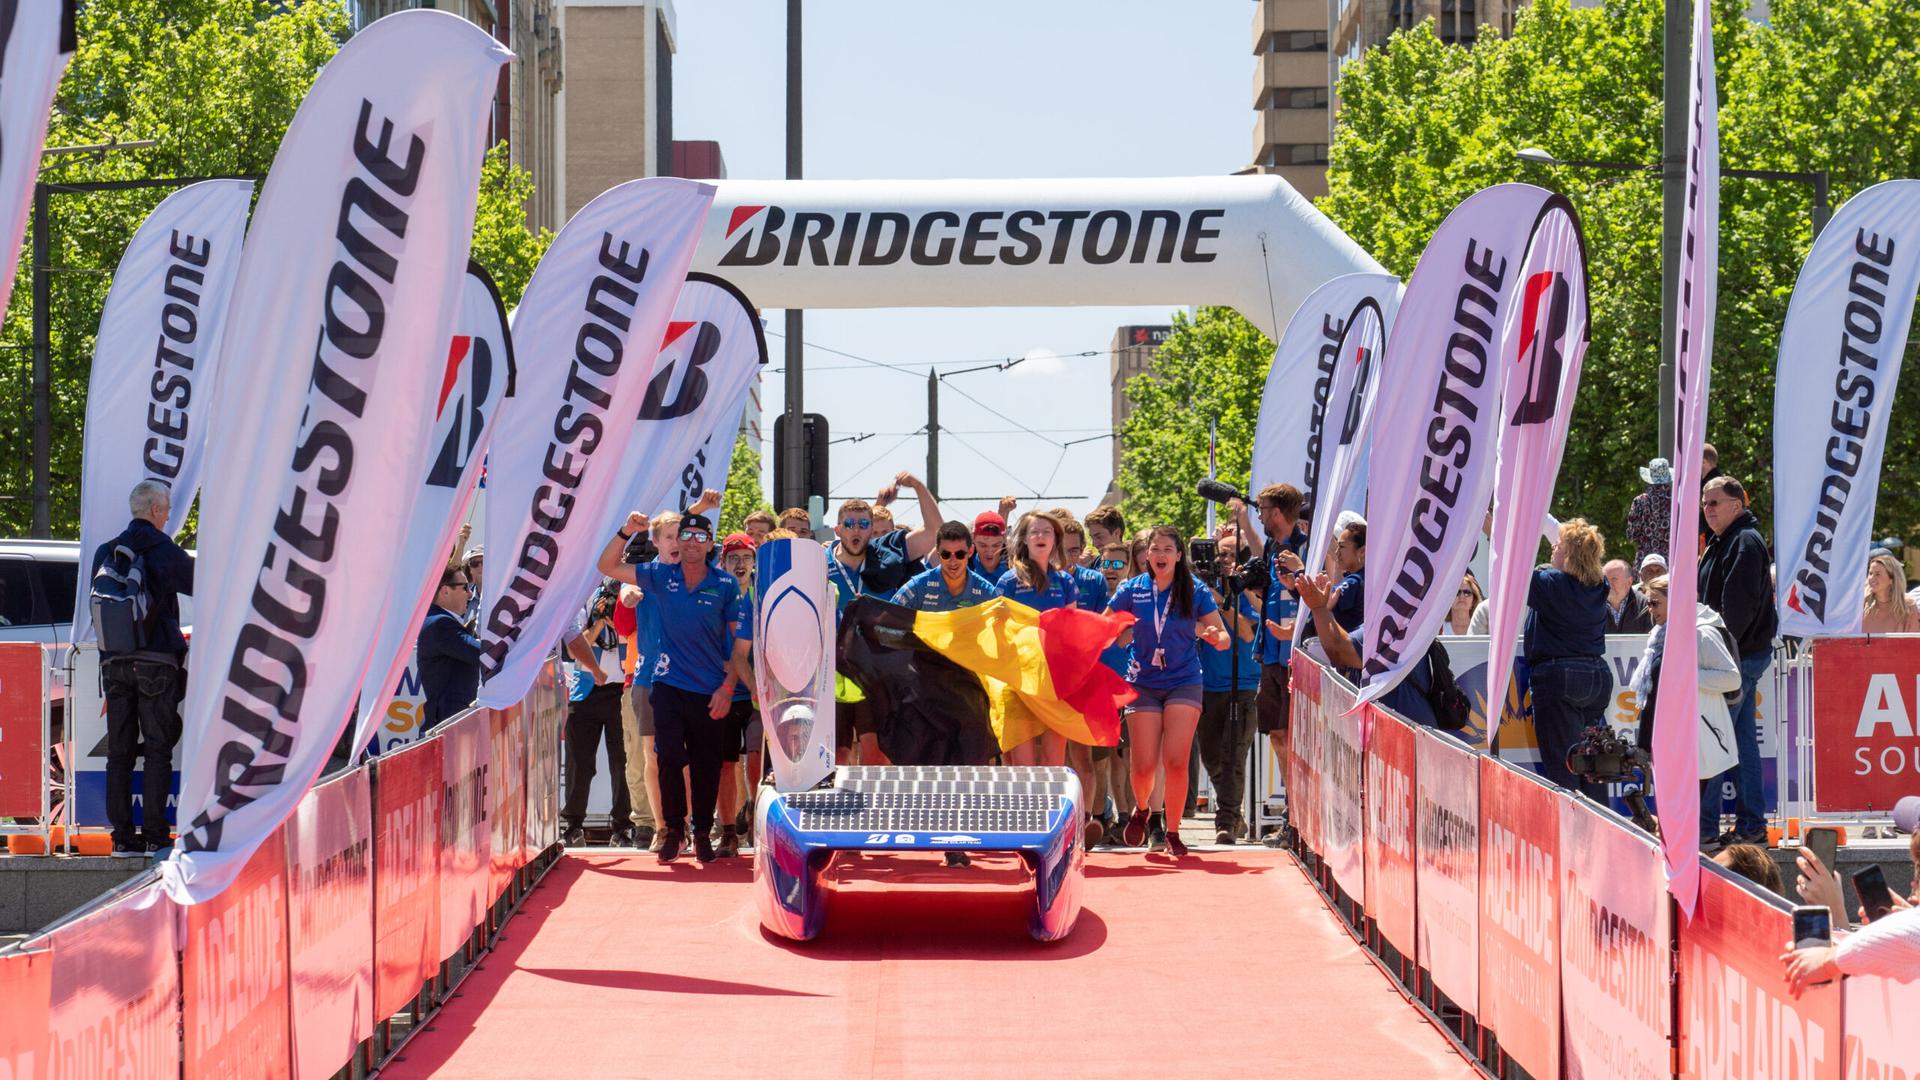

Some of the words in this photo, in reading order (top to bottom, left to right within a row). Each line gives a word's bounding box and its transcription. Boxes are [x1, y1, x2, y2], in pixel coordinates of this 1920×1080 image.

[717, 205, 1225, 266] BRIDGESTONE
[143, 229, 211, 489] GESTONE
[1786, 227, 1896, 625] BRIDGESTONE
[1485, 818, 1553, 965] ADELAIDE
[1566, 869, 1665, 1039] BRIDGESTONE
